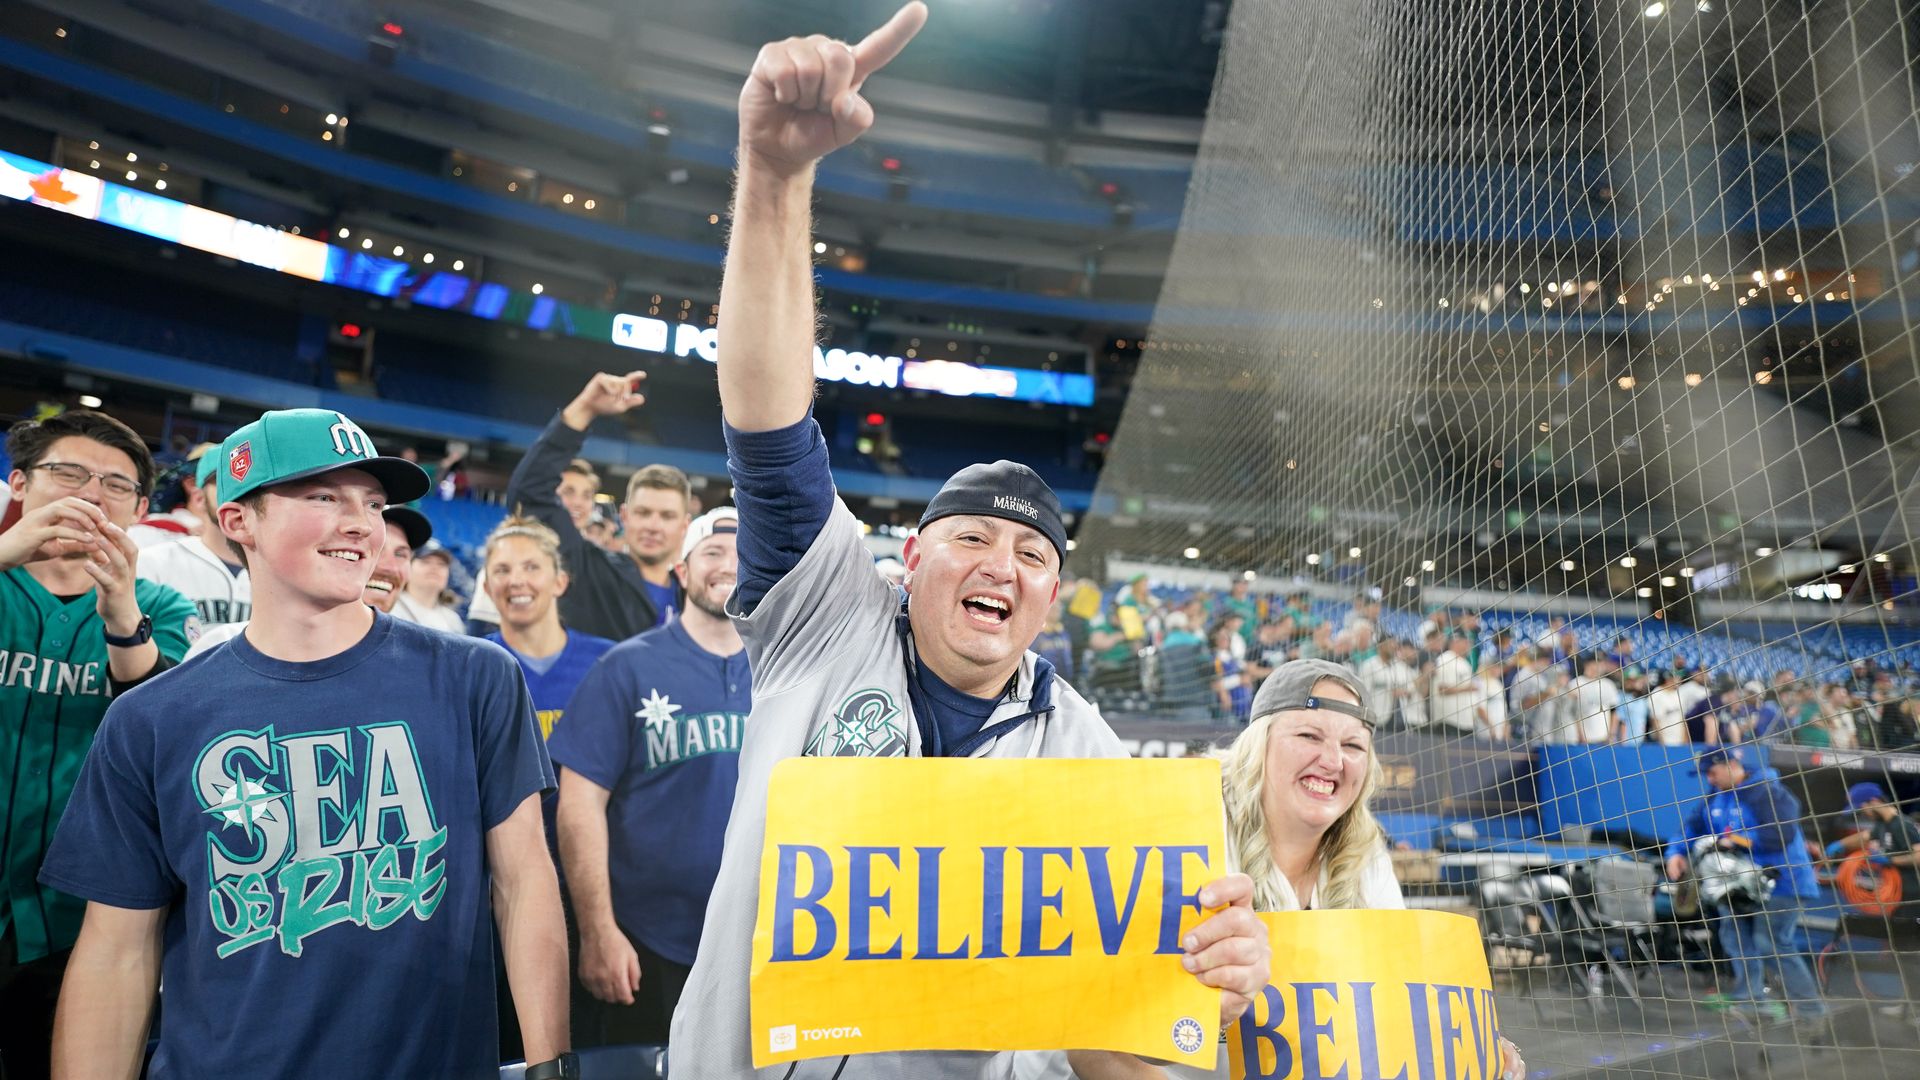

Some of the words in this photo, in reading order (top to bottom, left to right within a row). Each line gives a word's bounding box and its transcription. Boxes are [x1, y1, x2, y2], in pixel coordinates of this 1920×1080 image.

[993, 495, 1039, 520] MARINERS
[643, 712, 748, 772] MARI
[191, 720, 440, 889] SEA
[208, 872, 276, 940] US
[277, 824, 448, 959] RISE
[768, 843, 1210, 963] BELIEVE
[801, 1026, 862, 1041] TOYOTA
